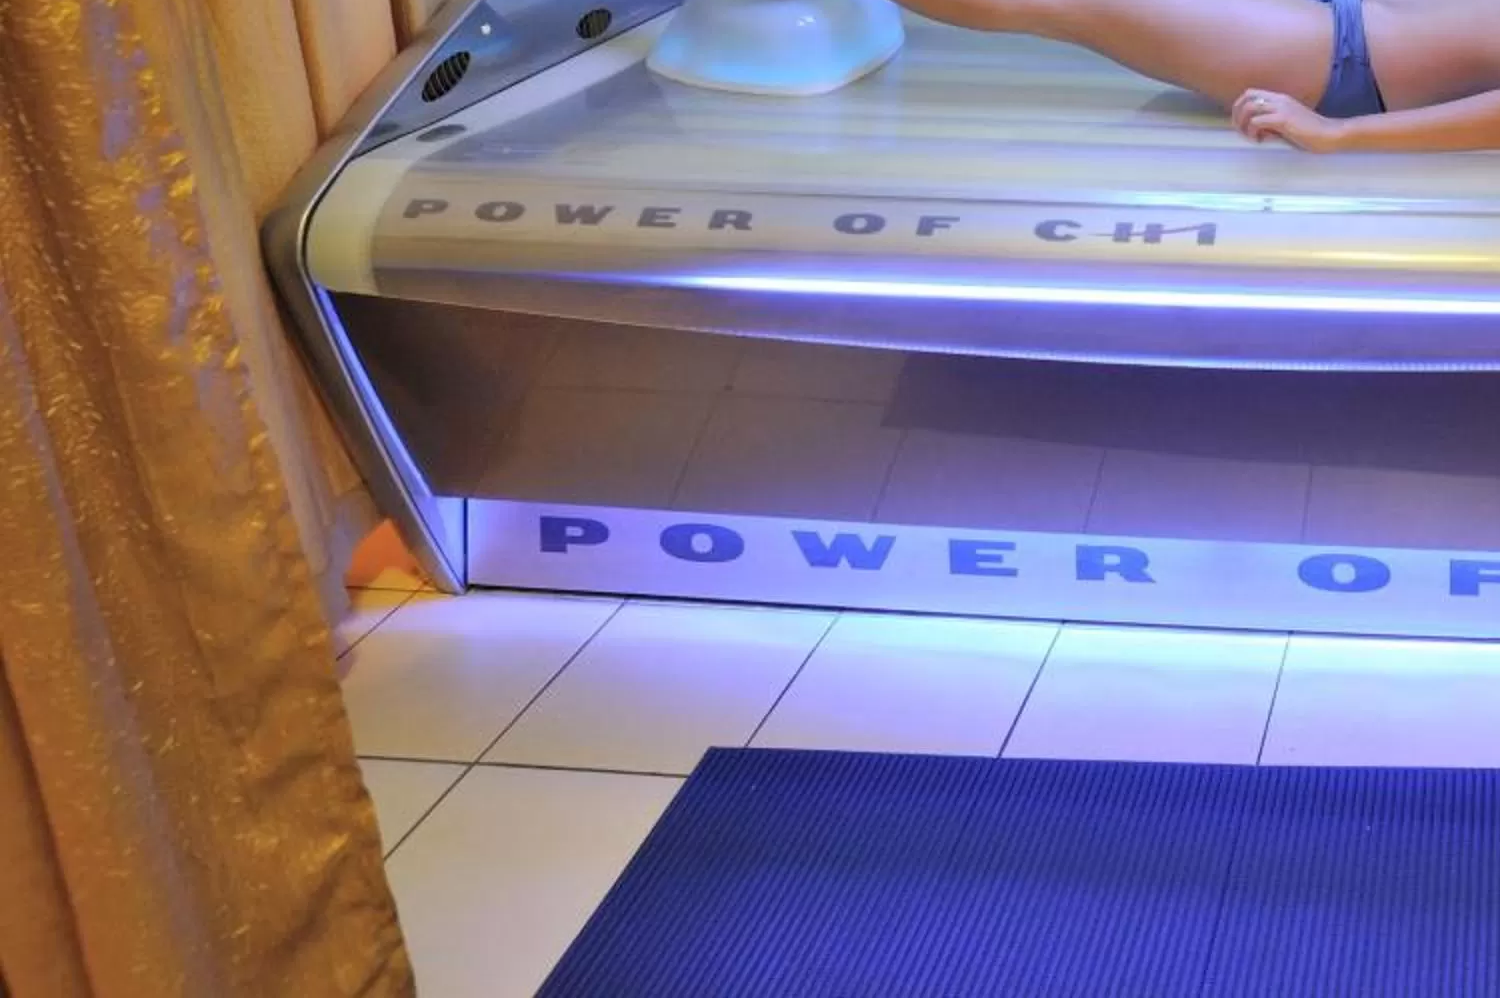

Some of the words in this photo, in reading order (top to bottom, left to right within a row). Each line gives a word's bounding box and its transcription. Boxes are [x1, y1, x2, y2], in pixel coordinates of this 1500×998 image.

[403, 199, 753, 233] POWER
[833, 212, 961, 238] OF
[539, 515, 1156, 584] POWER
